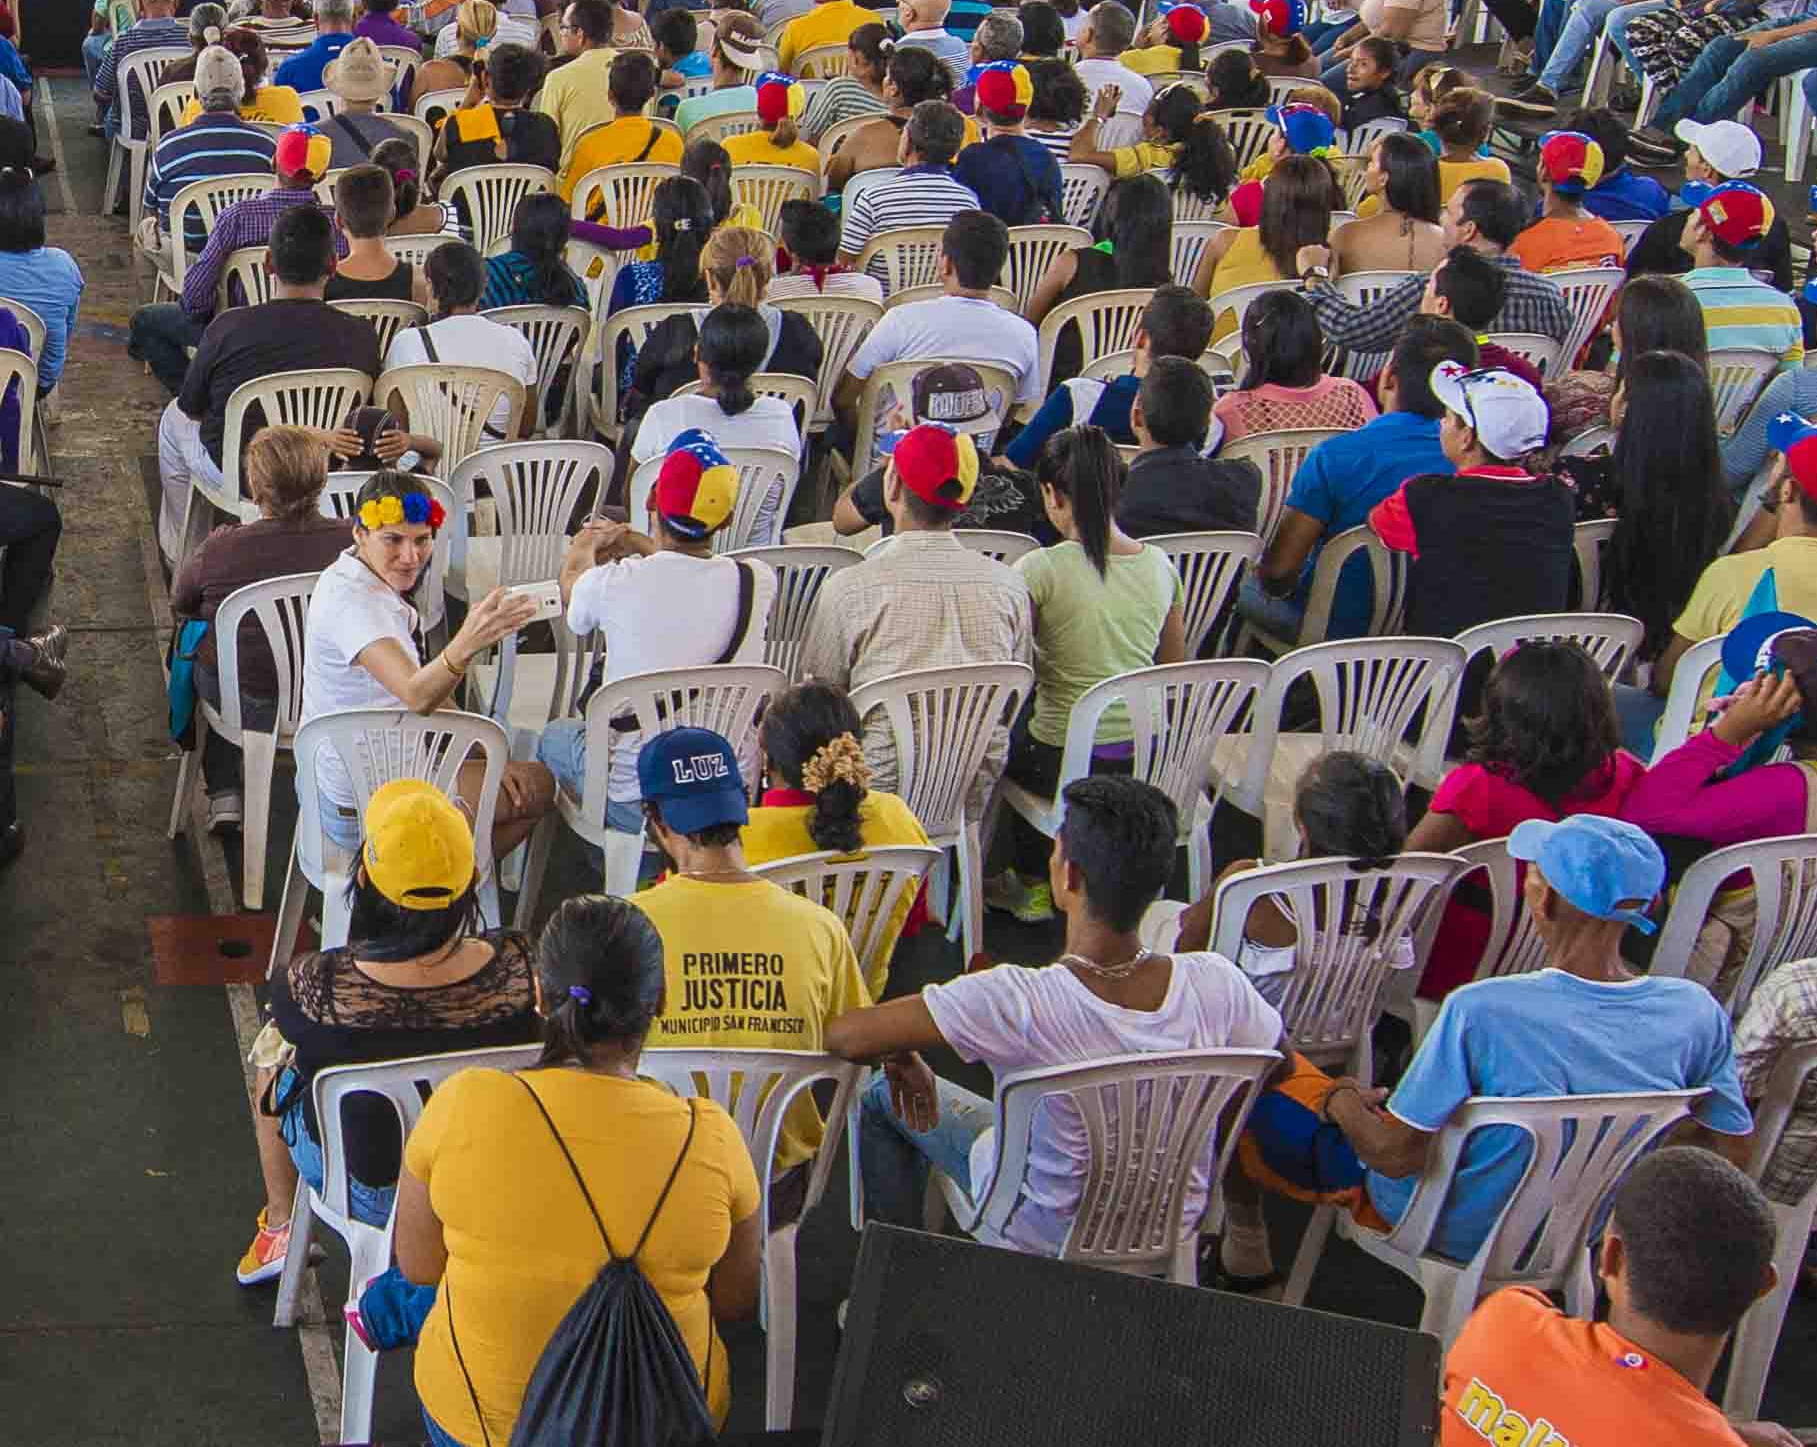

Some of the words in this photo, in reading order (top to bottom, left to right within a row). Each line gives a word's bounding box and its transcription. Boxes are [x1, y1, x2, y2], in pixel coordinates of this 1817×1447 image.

[672, 753, 728, 784] LUZ
[682, 952, 785, 977] PRIMERO
[680, 977, 787, 1012] JUSTICIA
[661, 1015, 720, 1035] MUNICIPIO
[722, 1013, 745, 1032] SAN
[747, 1016, 805, 1034] FRANCISCO
